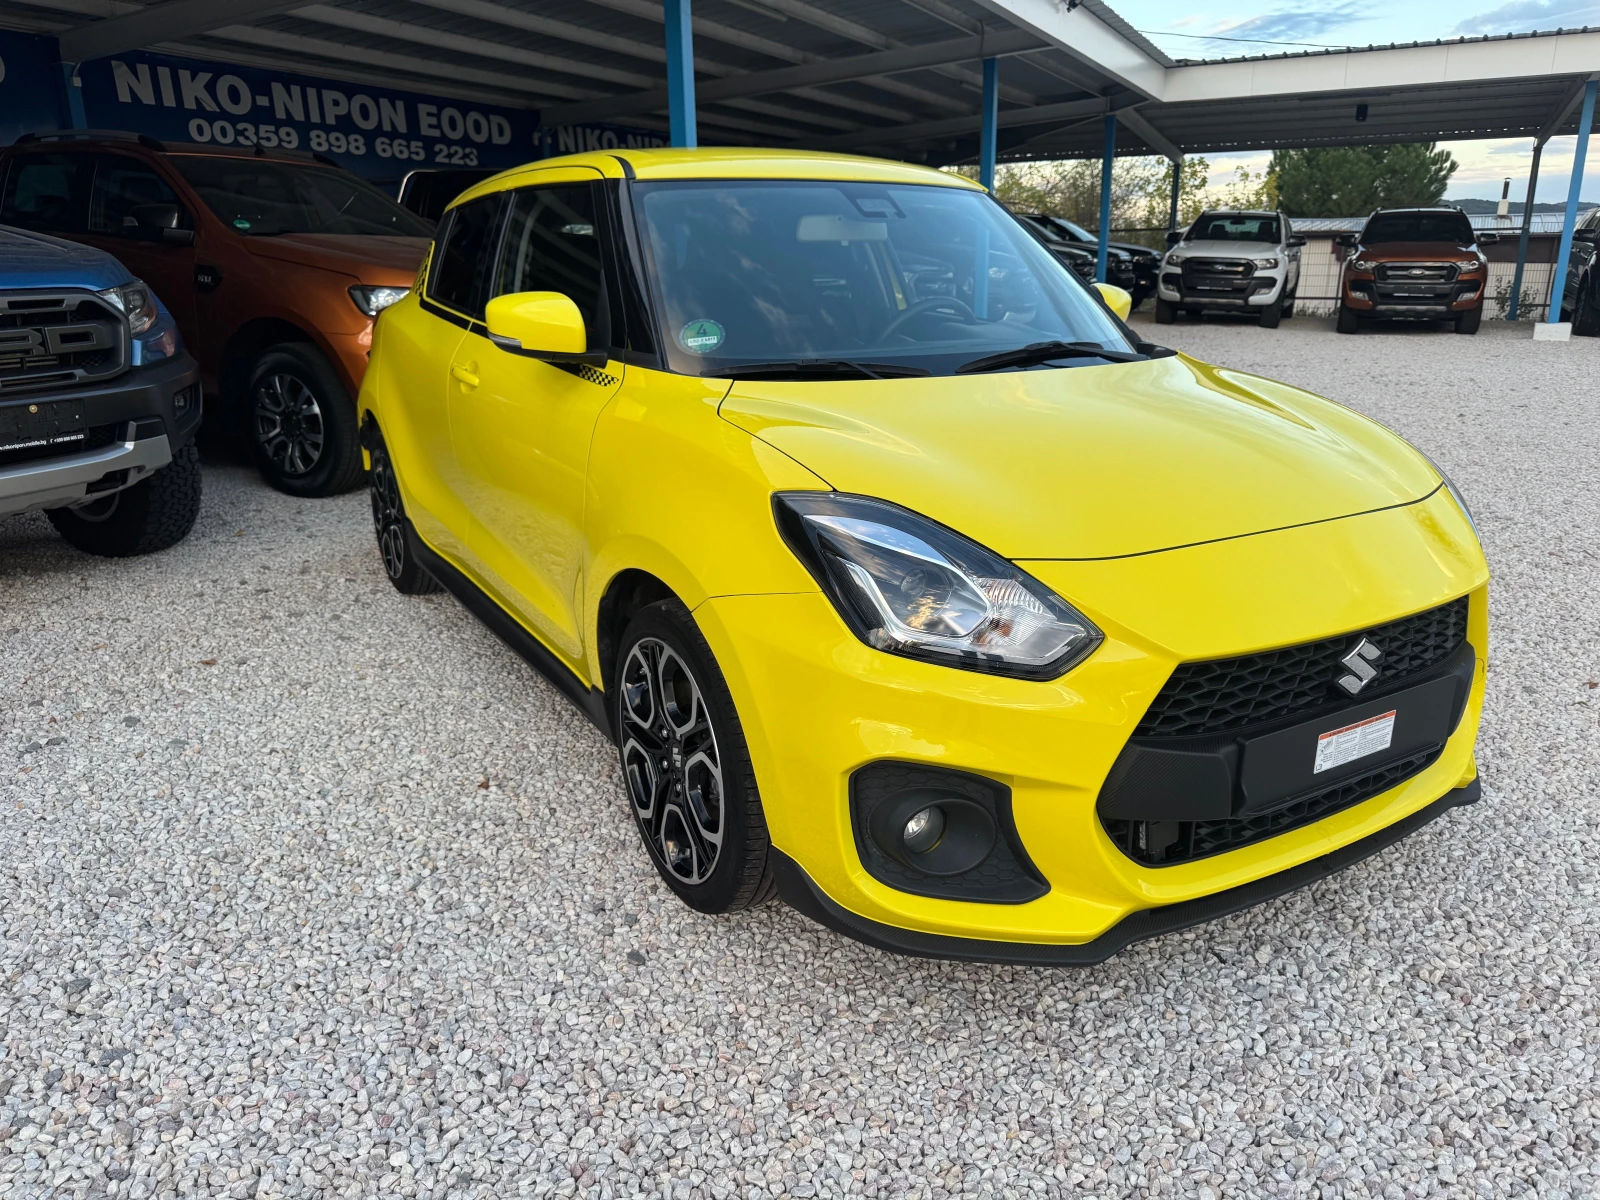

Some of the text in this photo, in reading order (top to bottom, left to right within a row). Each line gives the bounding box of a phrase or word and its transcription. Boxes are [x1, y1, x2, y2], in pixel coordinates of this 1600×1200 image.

[111, 60, 512, 145] NIKO-NIPON EOOD
[188, 118, 479, 167] 00359 898 665 223
[697, 323, 708, 335] 4
